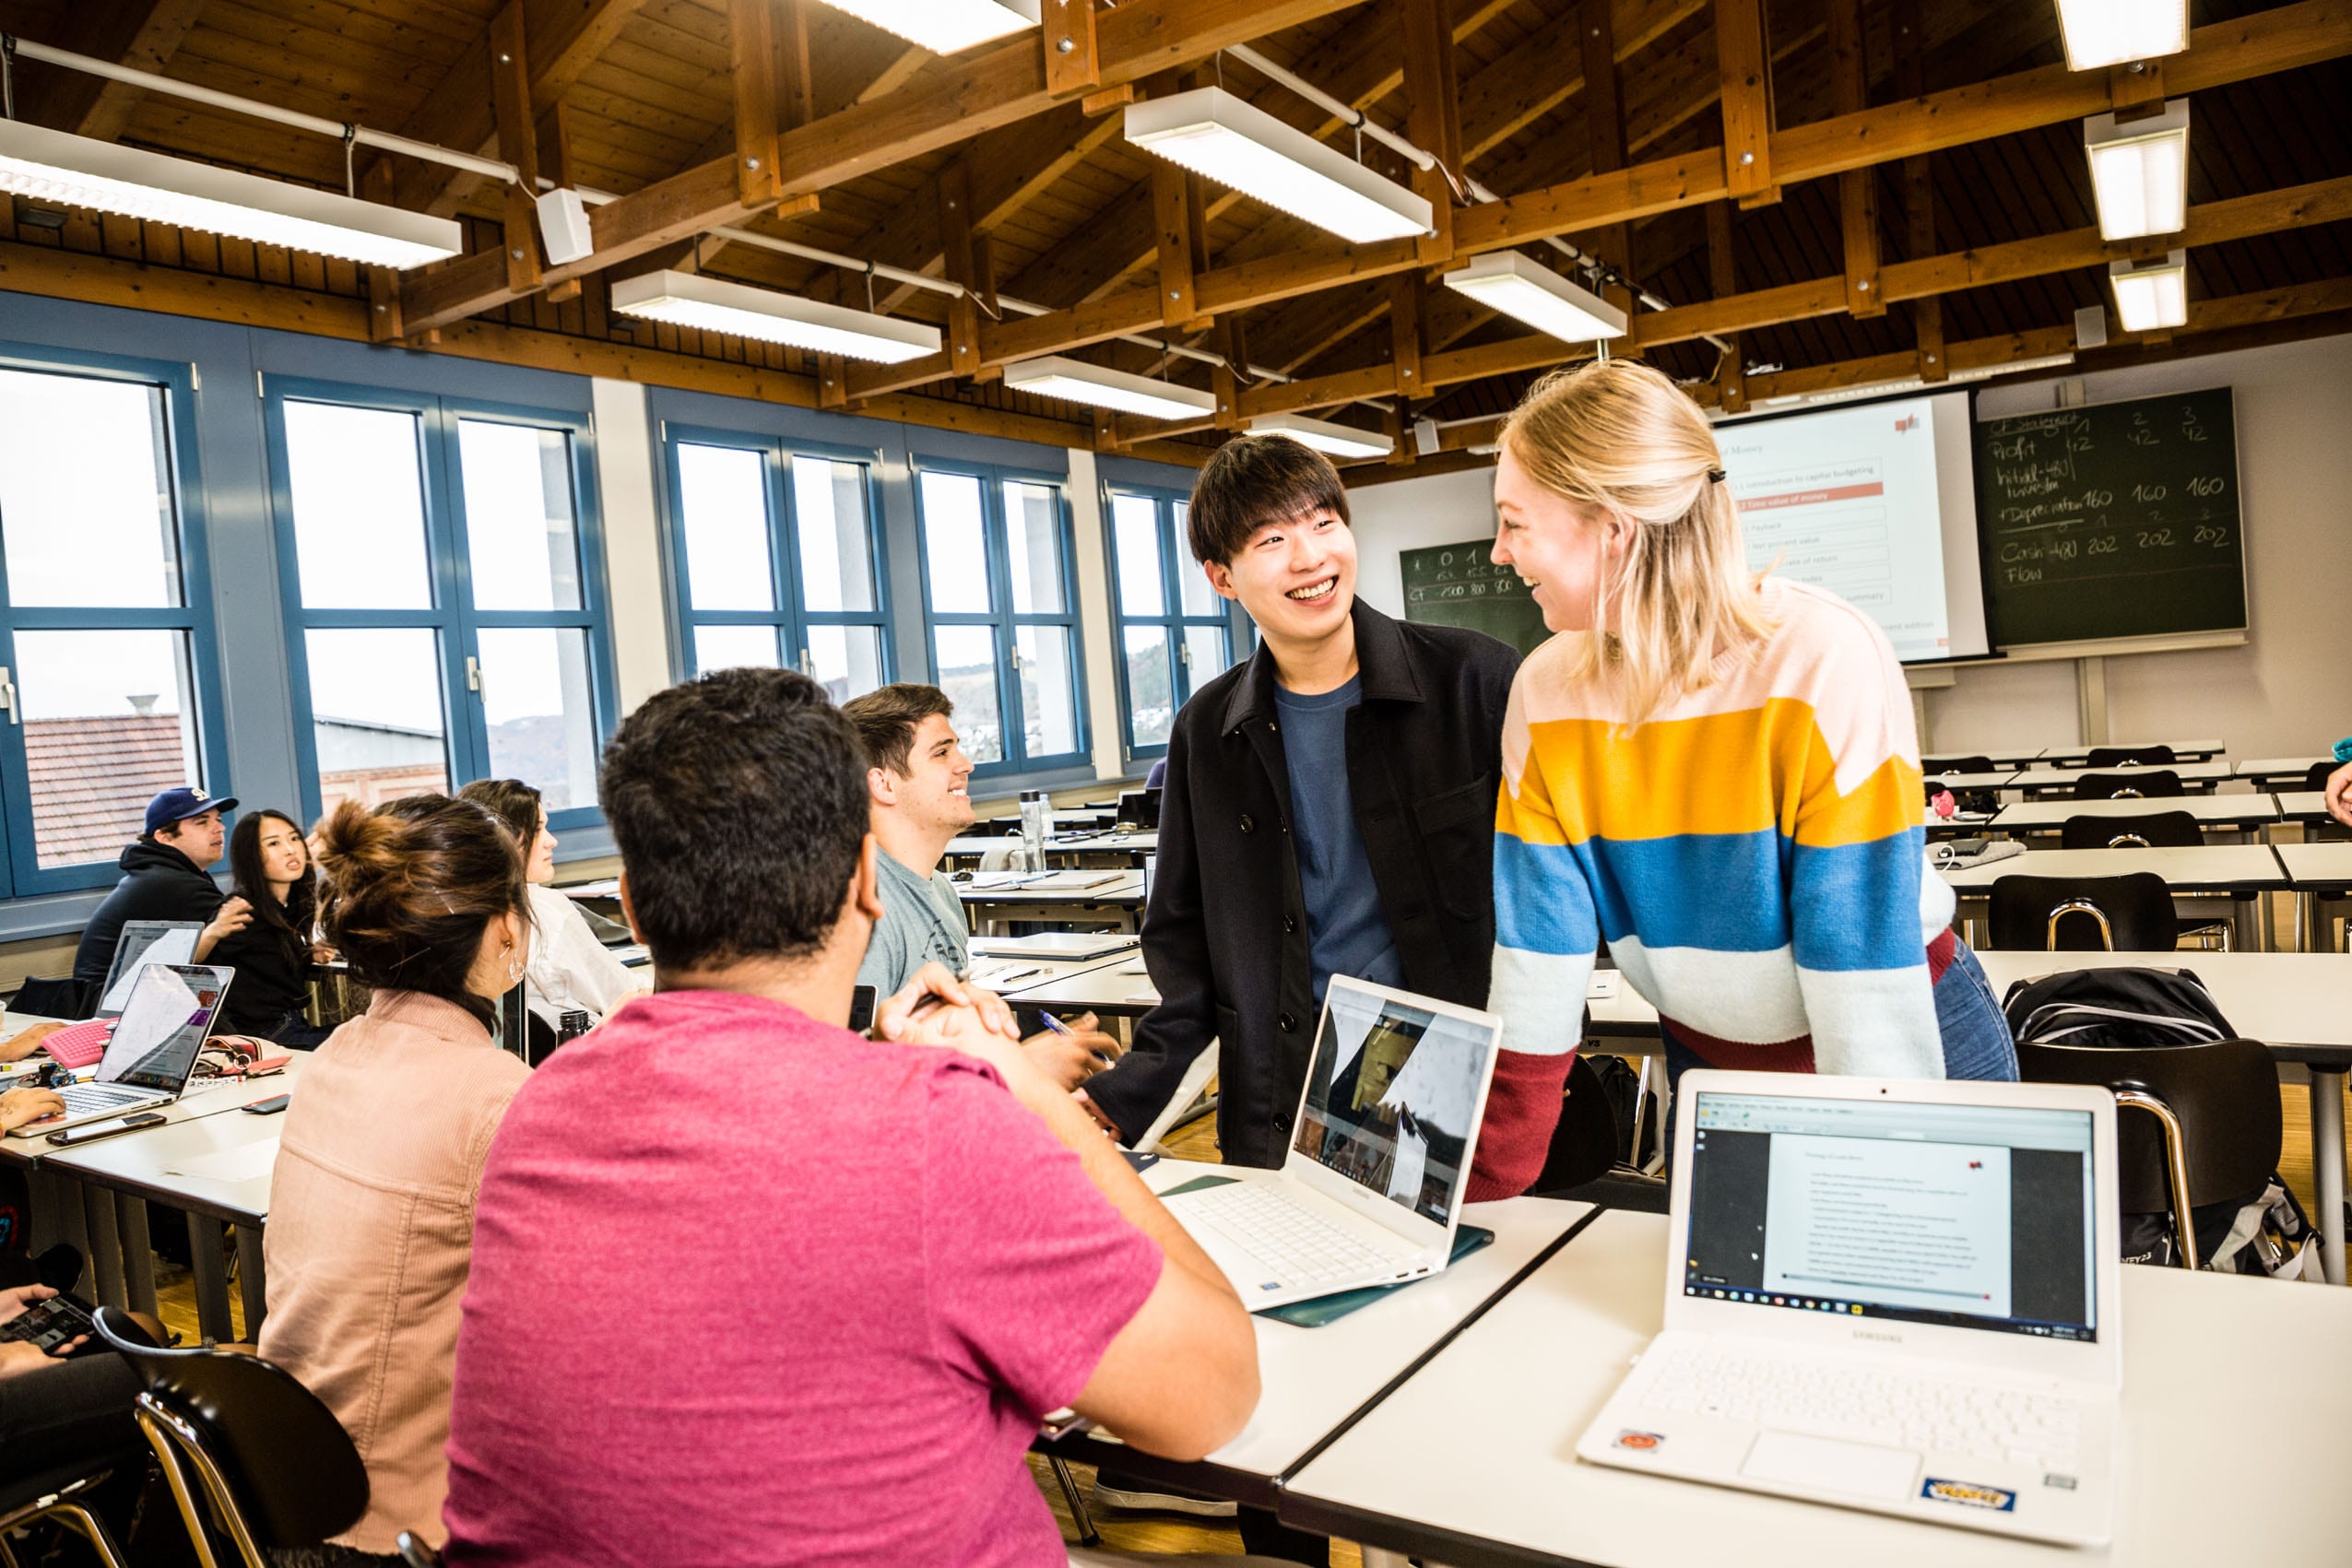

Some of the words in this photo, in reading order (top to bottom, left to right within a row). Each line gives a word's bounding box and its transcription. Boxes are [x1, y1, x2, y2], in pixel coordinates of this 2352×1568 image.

[2132, 411, 2149, 427] 2
[2181, 406, 2197, 426] 3
[1731, 443, 1764, 455] Money
[1988, 436, 2037, 462] Profit
[2127, 428, 2161, 446] 42
[2181, 424, 2208, 442] 42
[1794, 474, 1804, 485] to
[1805, 470, 1832, 484] capital
[1833, 465, 1874, 479] budgeting
[1748, 496, 1768, 509] Time
[1768, 495, 1790, 507] value
[1791, 492, 1800, 503] of
[1800, 491, 1829, 504] money
[2082, 489, 2112, 509] 160
[2131, 483, 2168, 503] 160
[2186, 477, 2225, 497] 160
[1800, 536, 1820, 545] value
[2087, 535, 2119, 556] 202
[2136, 527, 2176, 549] 202
[2192, 525, 2231, 549] 202
[1440, 551, 1454, 567] 0
[1466, 548, 1477, 566] 1
[1813, 554, 1838, 564] return
[2004, 564, 2043, 584] Flow
[1847, 592, 1885, 604] summary
